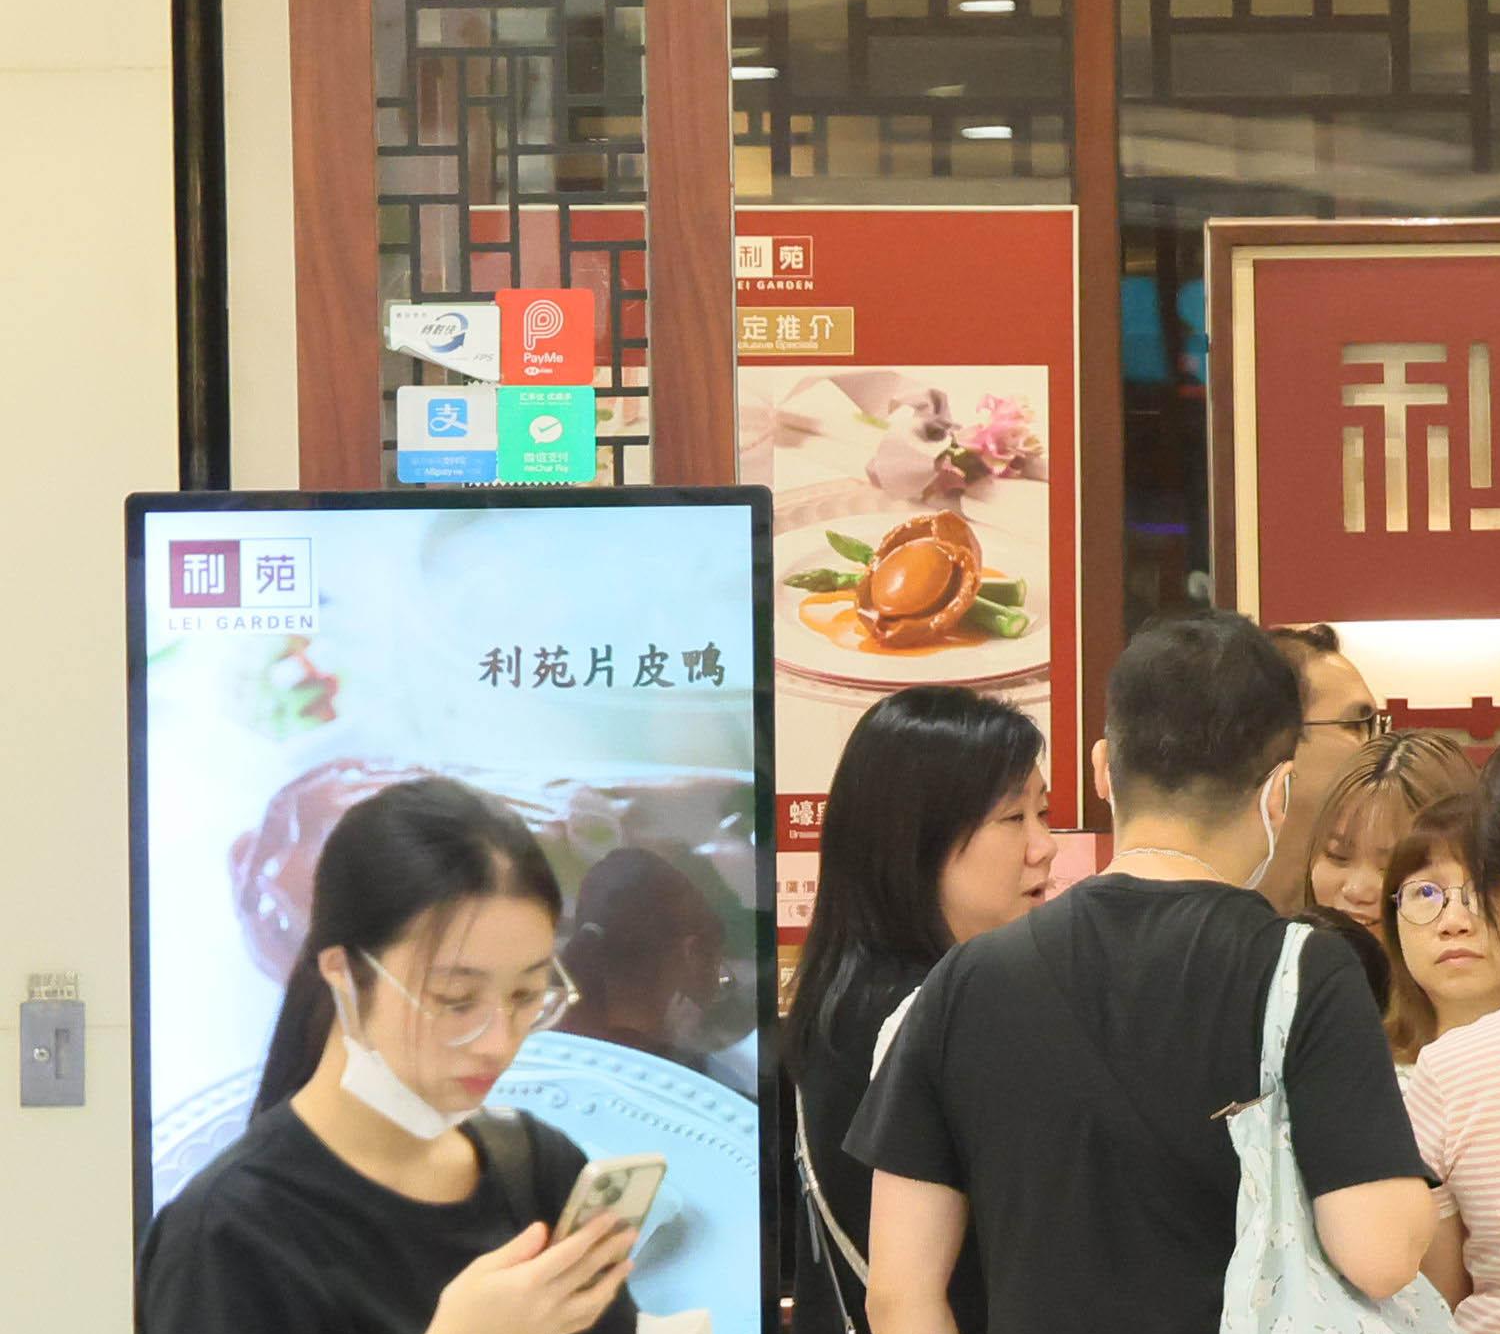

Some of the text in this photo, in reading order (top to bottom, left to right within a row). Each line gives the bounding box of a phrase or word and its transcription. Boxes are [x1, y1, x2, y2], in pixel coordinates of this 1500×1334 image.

[737, 280, 815, 291] EI GARDEN
[523, 351, 564, 365] PayMe
[182, 553, 297, 595] 利苑
[168, 614, 314, 631] LEI GARDEN
[477, 640, 726, 689] 利苑片皮鴨
